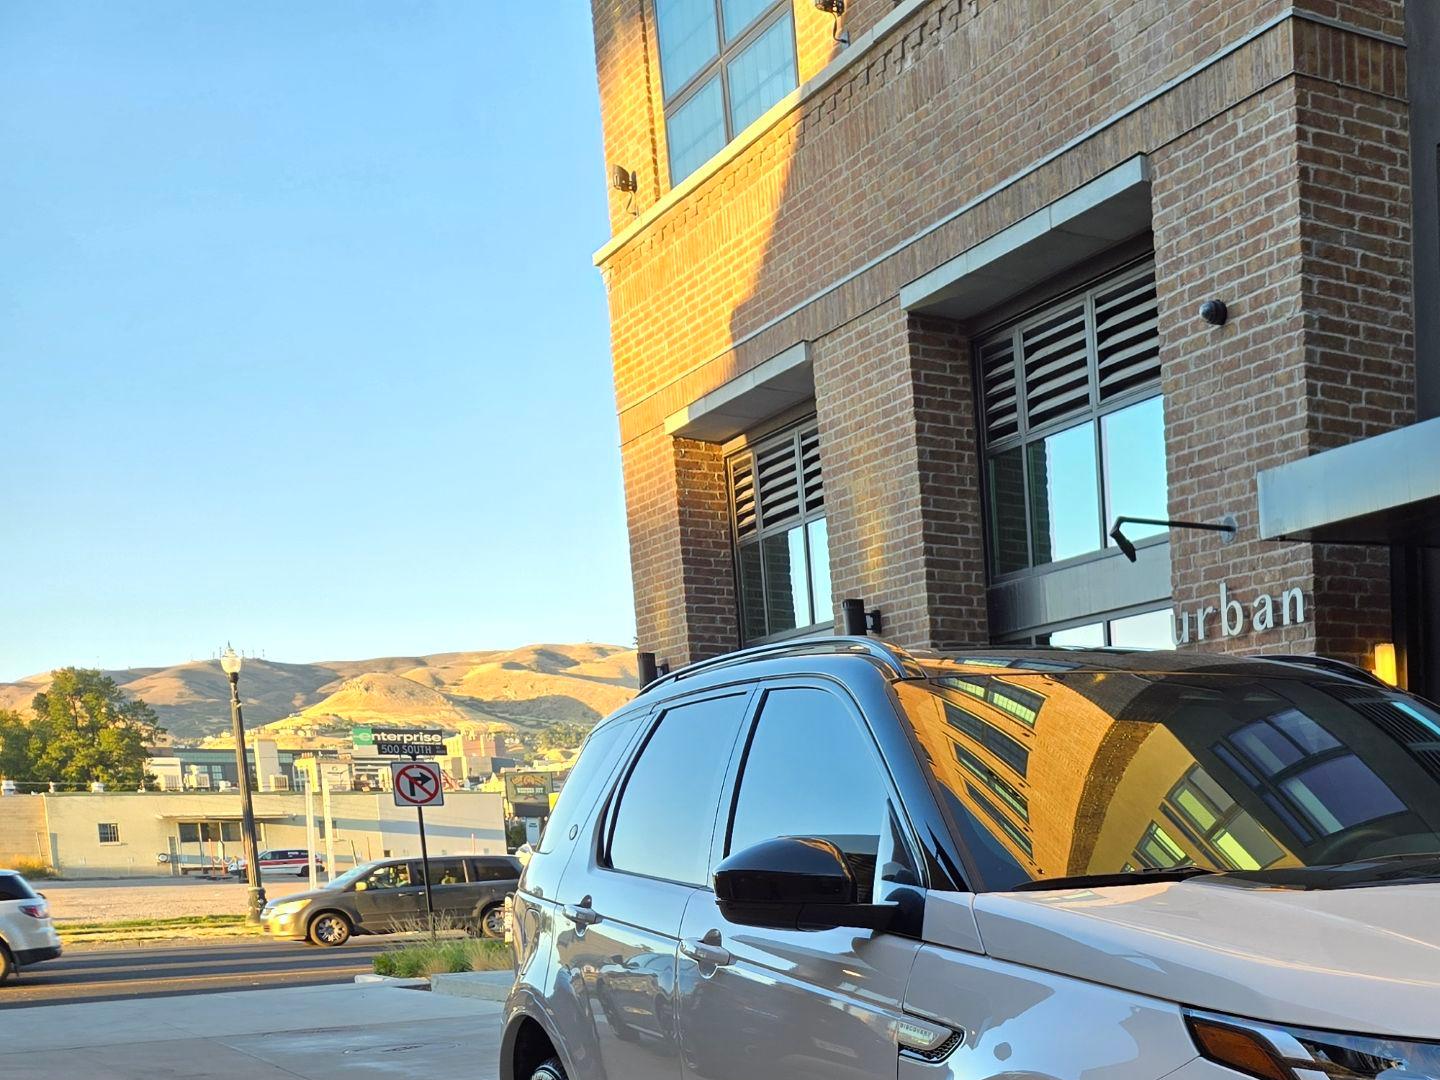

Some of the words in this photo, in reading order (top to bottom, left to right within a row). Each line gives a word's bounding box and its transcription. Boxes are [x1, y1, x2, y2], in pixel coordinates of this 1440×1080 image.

[1170, 582, 1305, 645] urban
[358, 732, 442, 744] enterprise
[381, 744, 399, 754] 500
[401, 745, 432, 754] SOUTH
